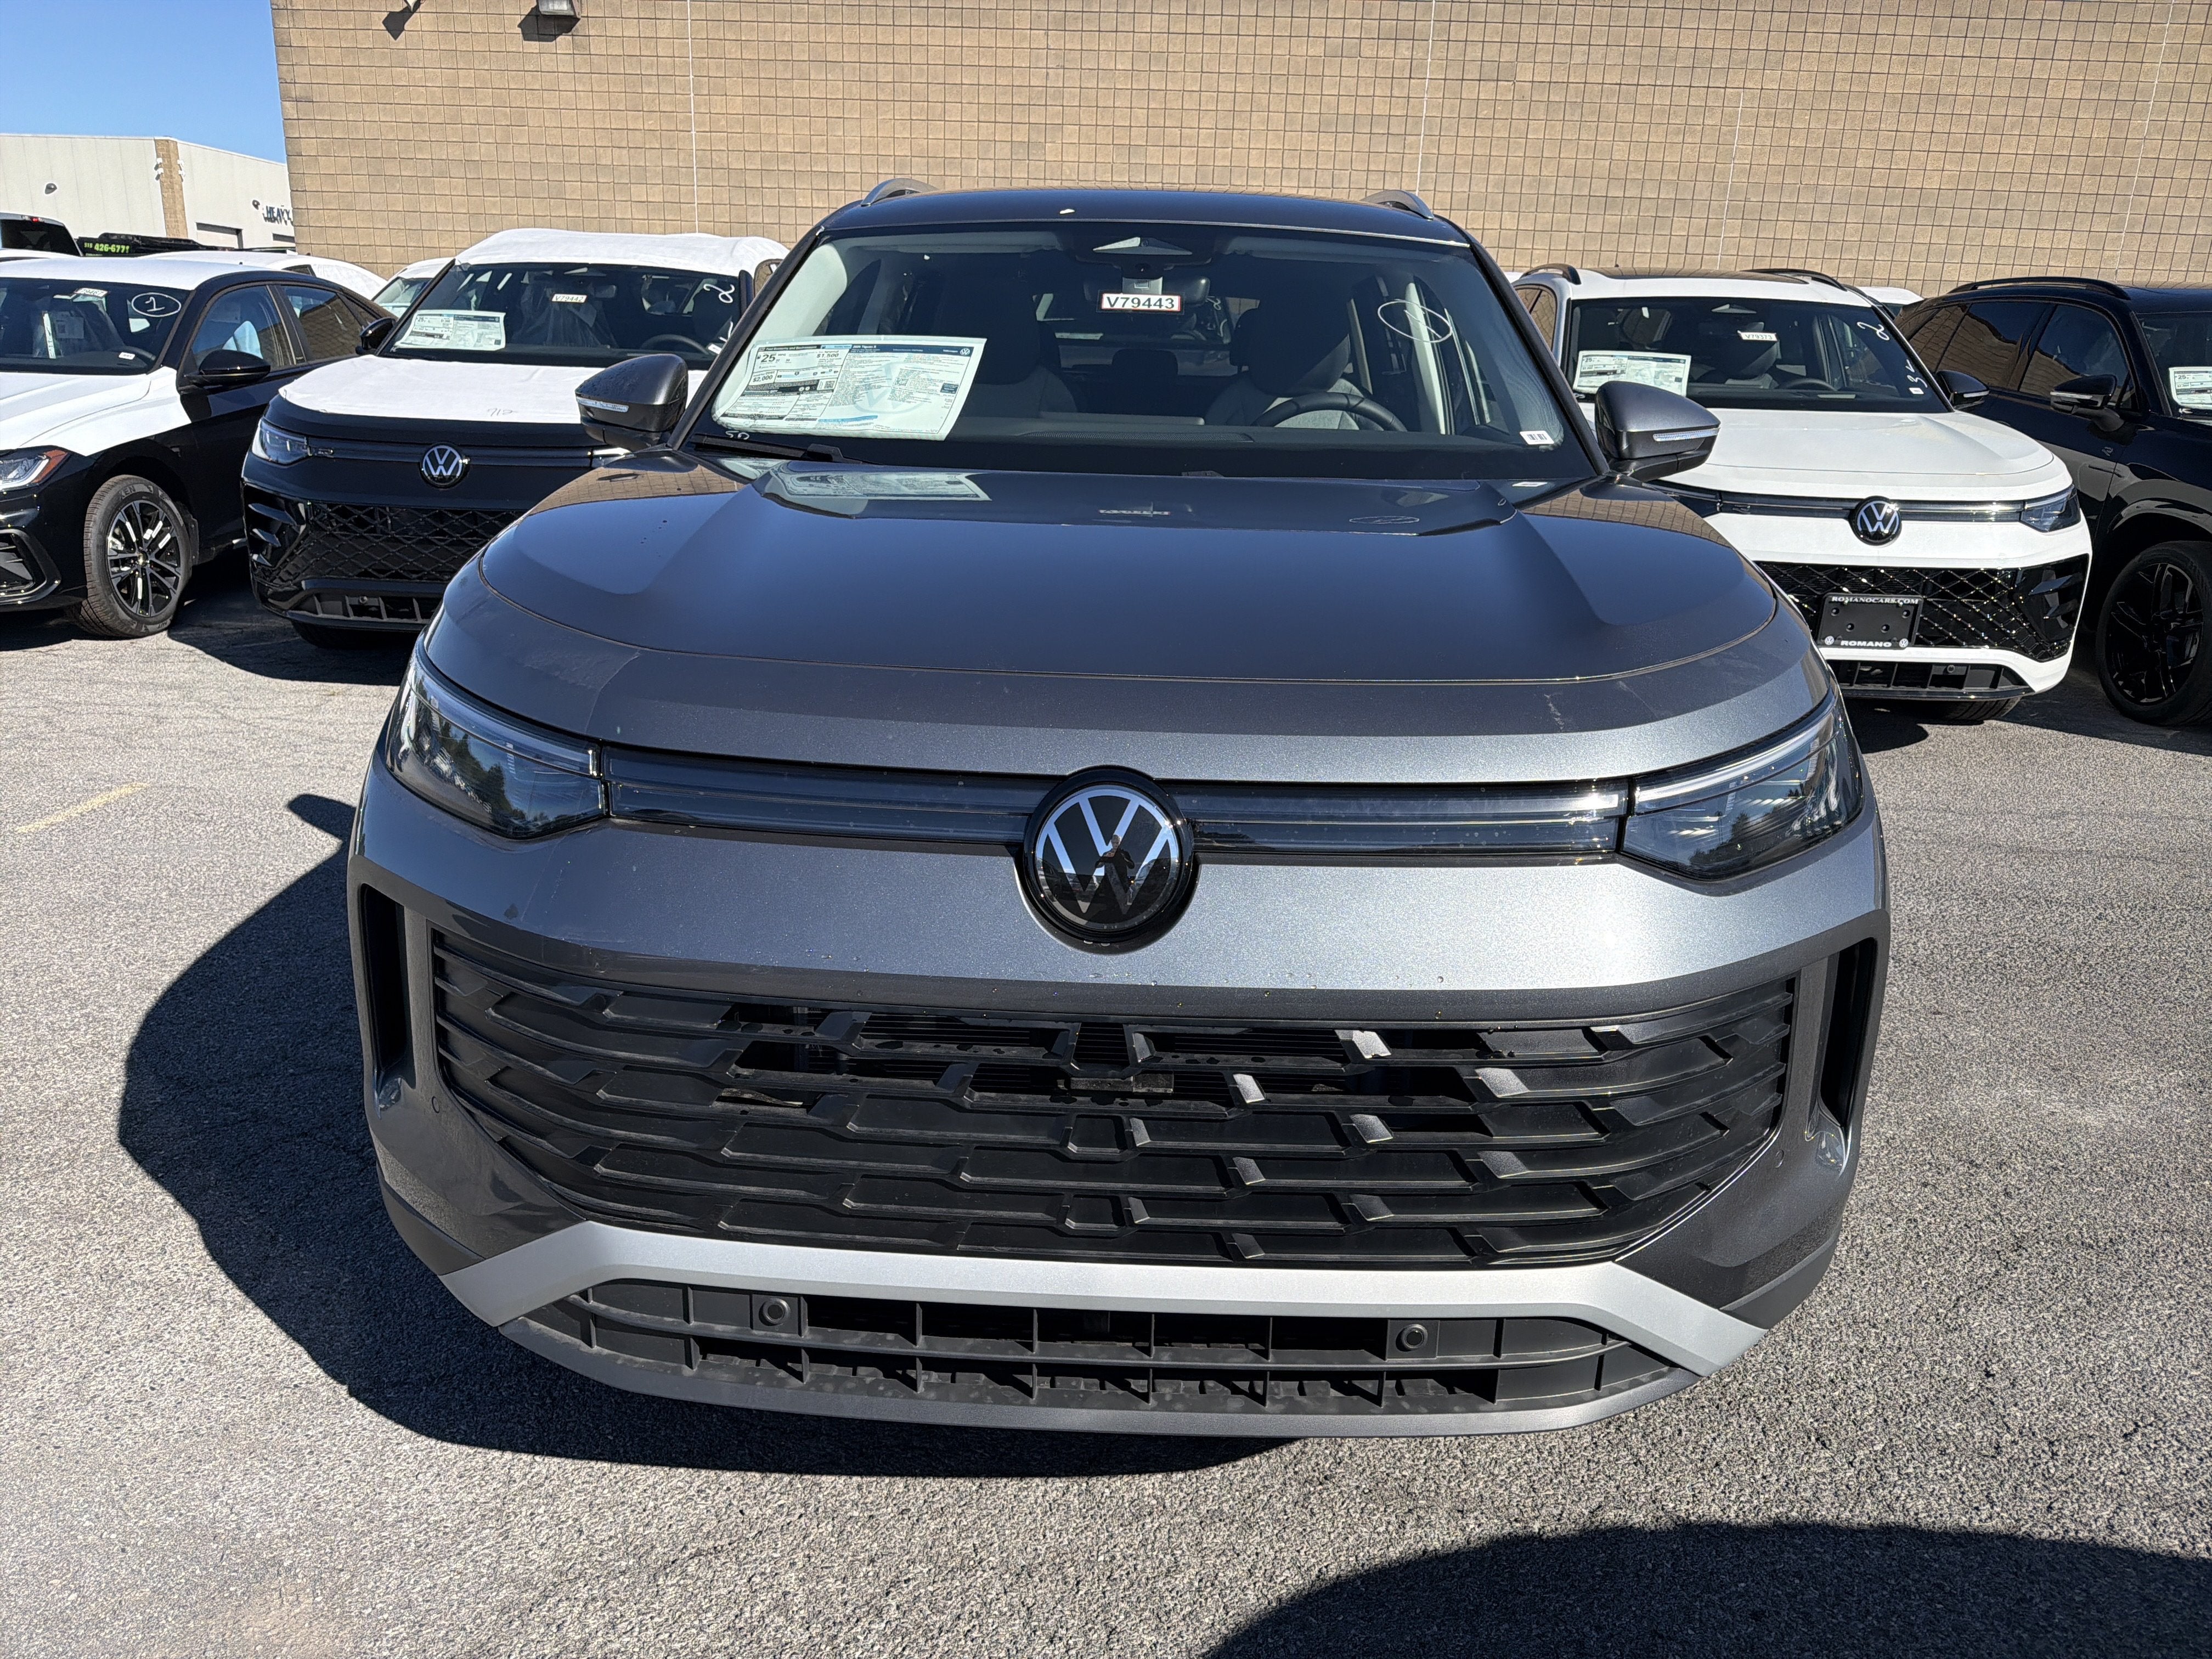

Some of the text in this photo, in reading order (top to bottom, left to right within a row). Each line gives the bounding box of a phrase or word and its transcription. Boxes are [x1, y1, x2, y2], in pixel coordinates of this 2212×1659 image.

[1107, 297, 1175, 309] V79443
[761, 354, 777, 363] 25
[753, 375, 773, 383] $2,000
[1832, 596, 1919, 605] ROMANOCARS.COM
